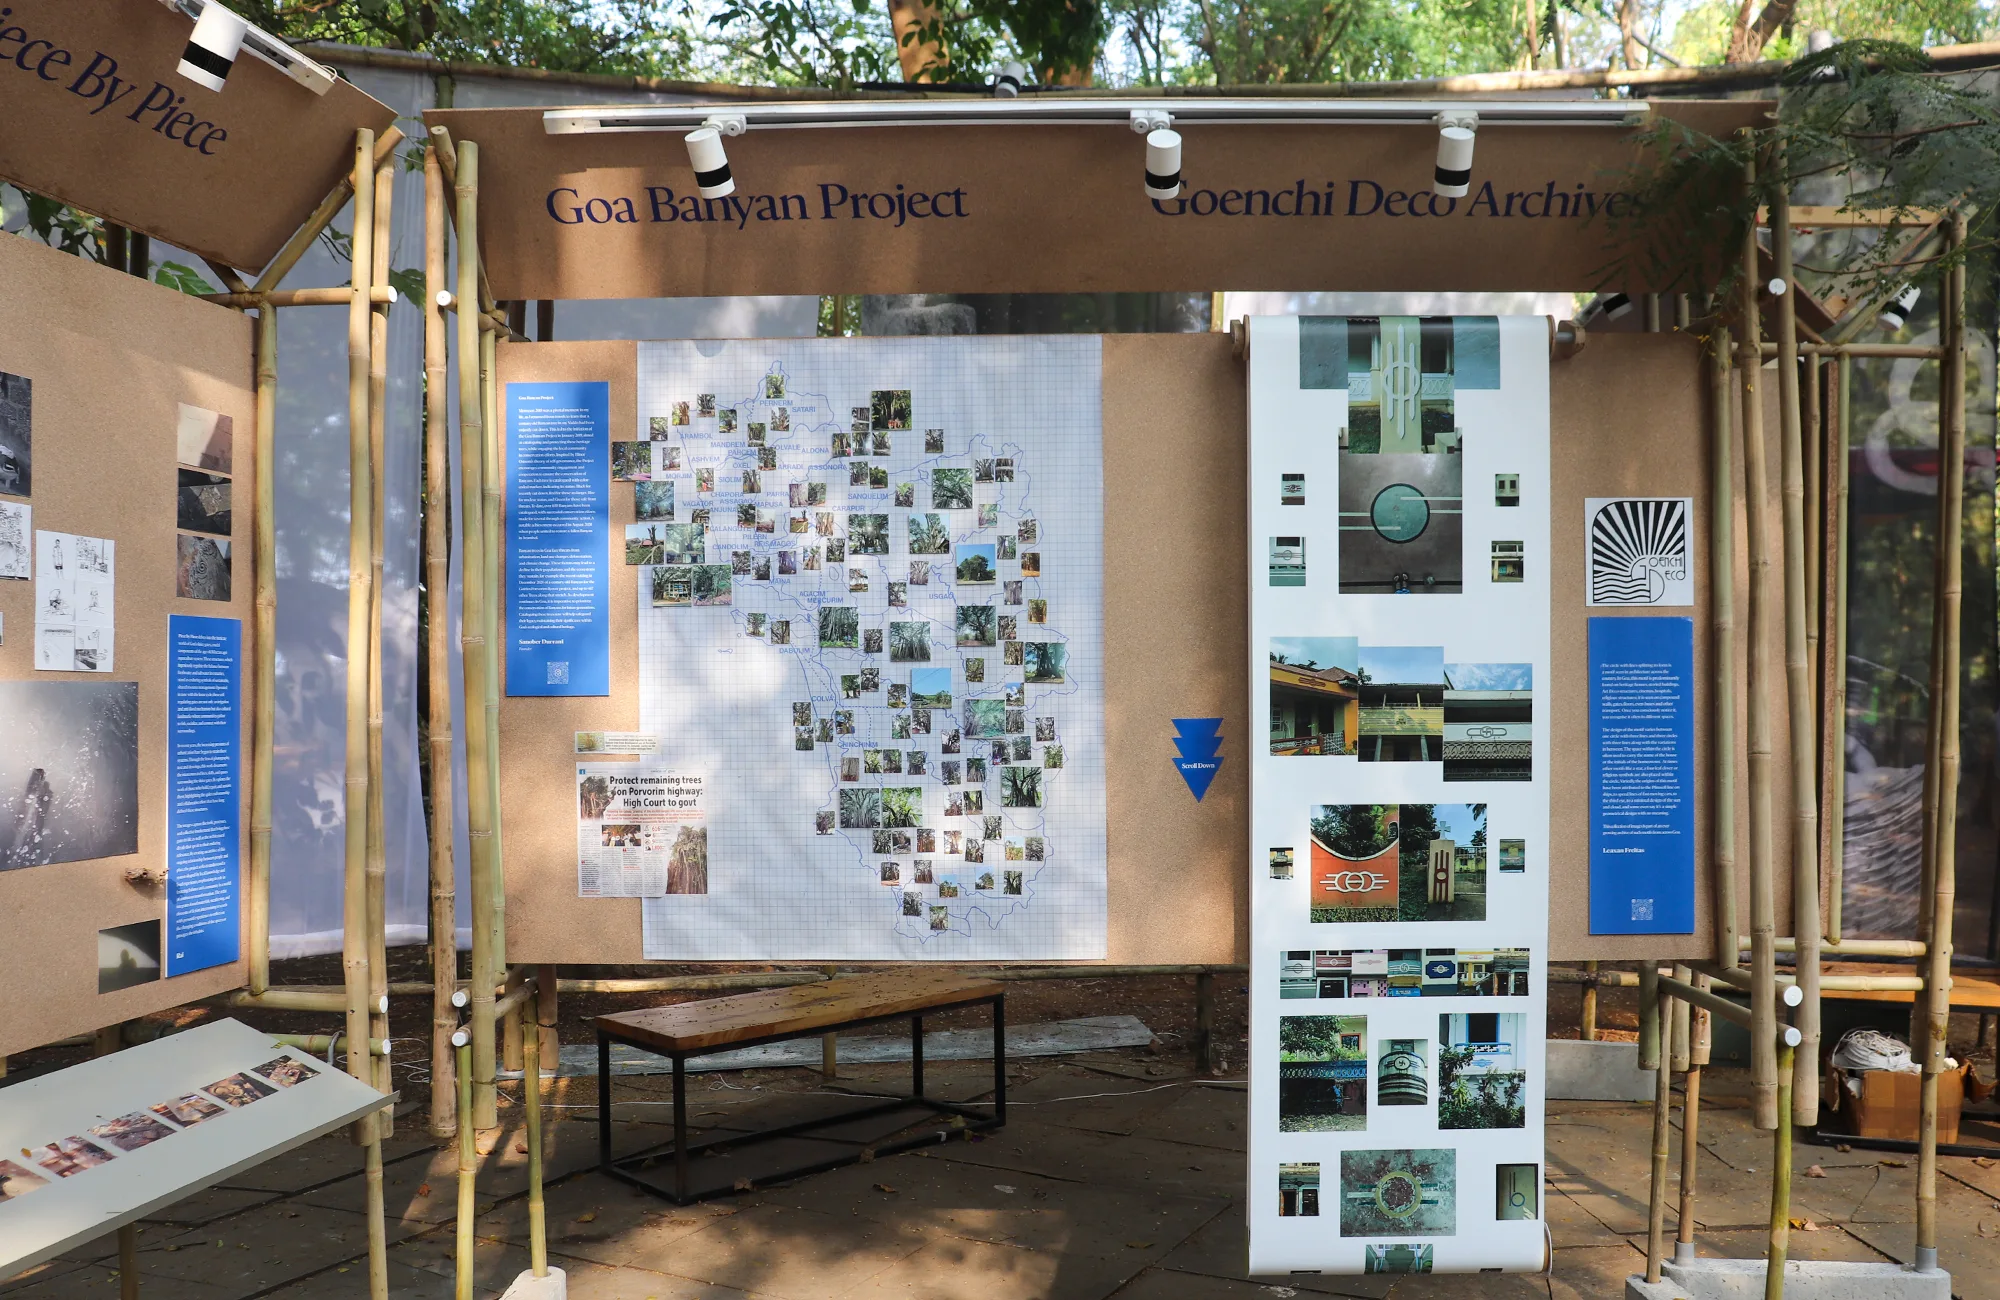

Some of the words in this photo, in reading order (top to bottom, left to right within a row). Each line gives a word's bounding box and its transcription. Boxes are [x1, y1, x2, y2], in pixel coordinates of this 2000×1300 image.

[65, 50, 137, 116] By
[126, 81, 228, 155] Piece
[545, 187, 639, 225] Goa
[644, 185, 811, 230] Banyan
[817, 183, 970, 228] Project
[1151, 178, 1335, 217] Goenchi
[1343, 179, 1456, 217] Deco
[609, 775, 639, 785] Protect
[640, 775, 680, 787] remaining
[682, 776, 702, 785] trees
[629, 787, 665, 796] Porvorim
[667, 786, 703, 798] highway:
[623, 798, 642, 809] High
[643, 798, 666, 808] Court
[668, 798, 677, 807] to
[678, 799, 697, 809] govt
